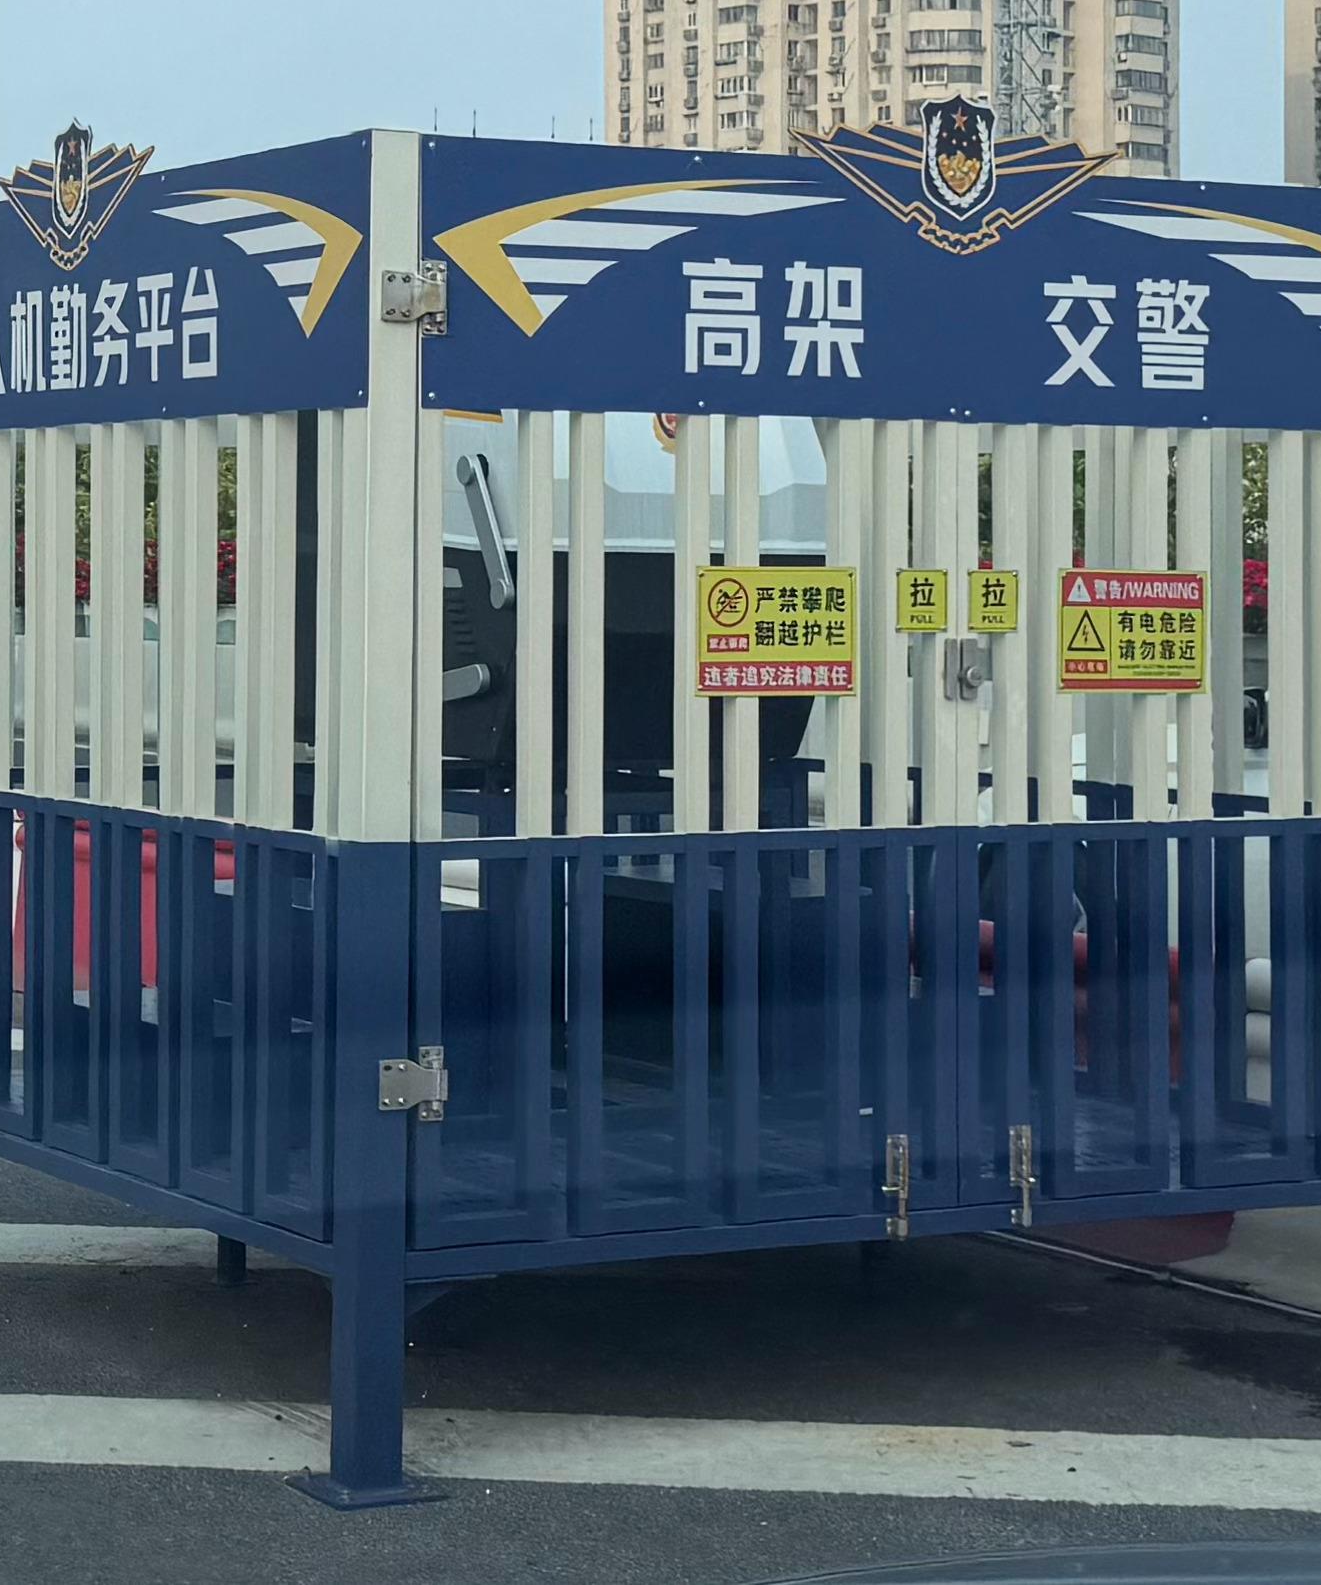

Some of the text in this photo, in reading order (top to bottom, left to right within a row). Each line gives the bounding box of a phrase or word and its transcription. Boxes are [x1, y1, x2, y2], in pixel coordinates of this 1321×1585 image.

[681, 257, 1211, 390] 高架 交警
[755, 586, 846, 613] 严禁攀爬
[910, 577, 935, 608] 拉
[982, 578, 1006, 608] 拉
[755, 620, 846, 646] 翻越护栏
[1118, 610, 1196, 633] 有电危险
[1118, 639, 1196, 661] 请勿靠近
[704, 666, 848, 686] 违者追究法律责任
